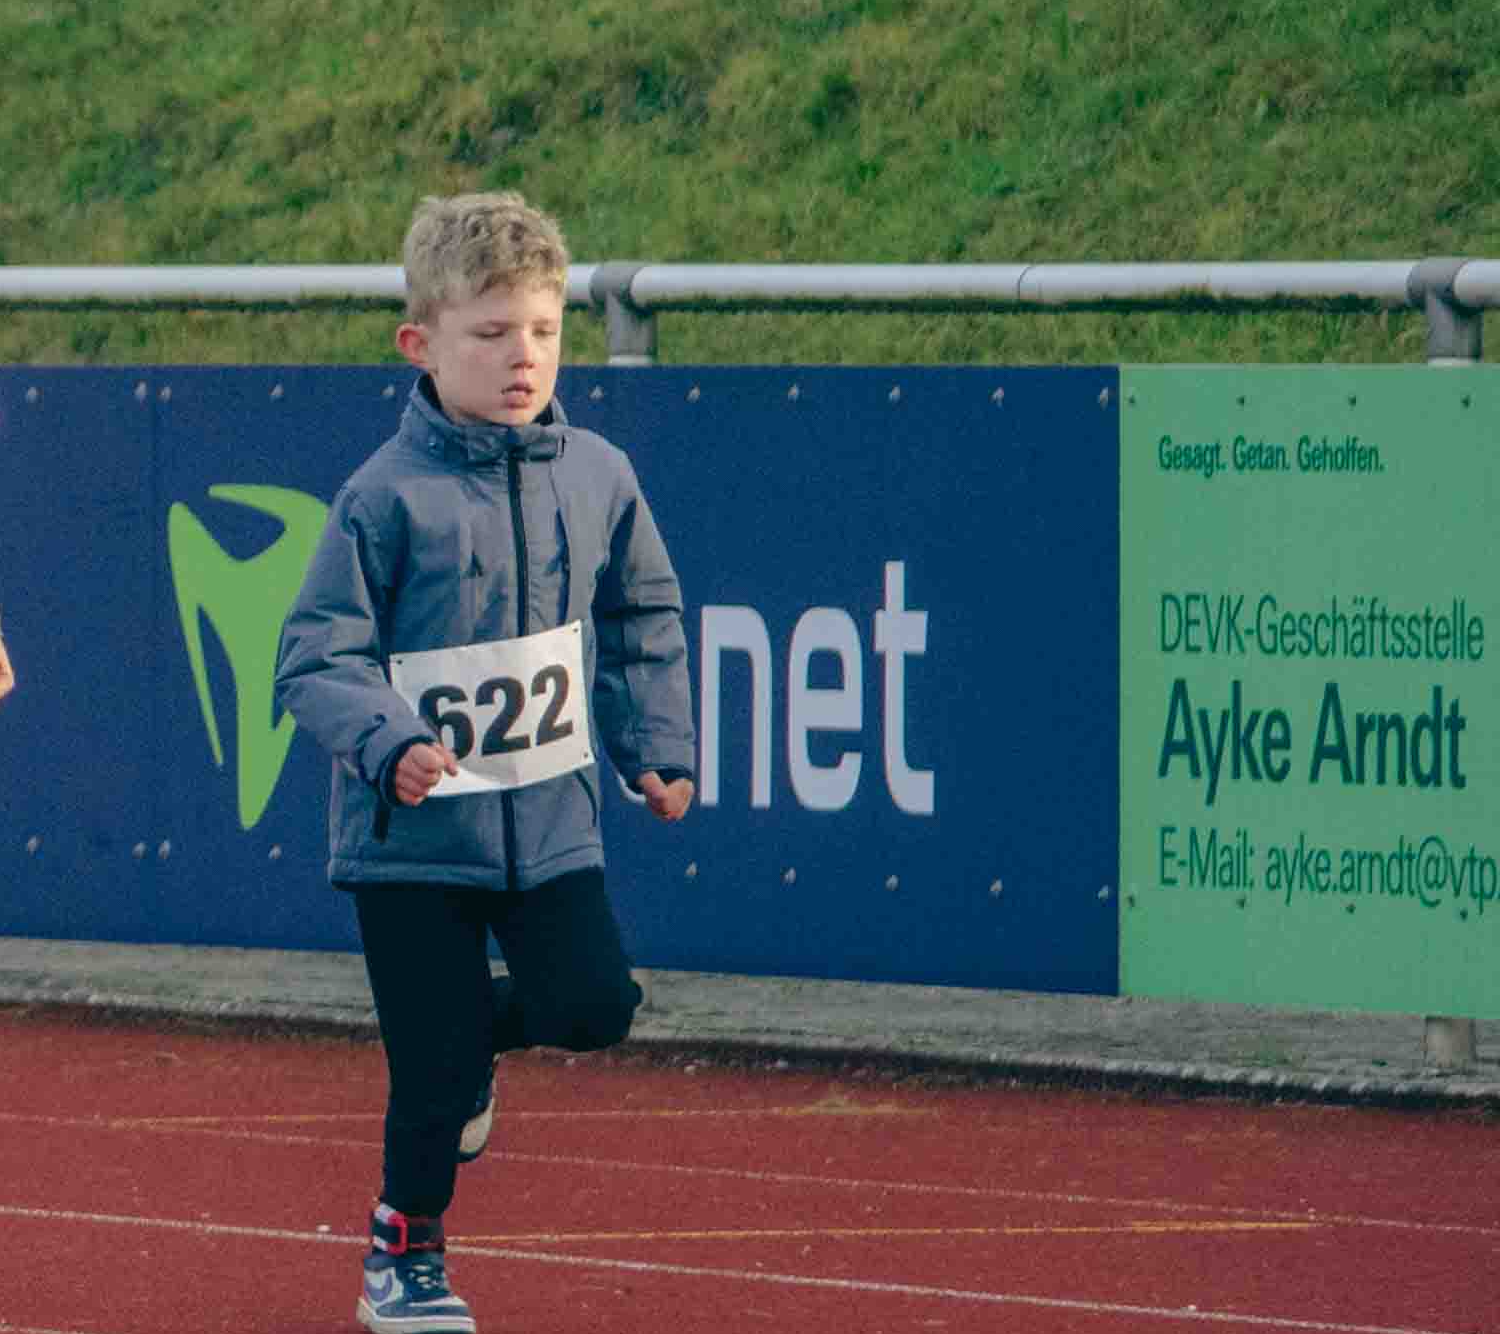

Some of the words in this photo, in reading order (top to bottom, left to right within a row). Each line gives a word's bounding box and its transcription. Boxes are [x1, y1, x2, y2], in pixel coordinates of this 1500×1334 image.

[1158, 434, 1228, 478] Gesagt.
[1232, 434, 1291, 471] Getan.
[1297, 435, 1386, 473] Geholfen.
[1159, 593, 1485, 661] DEVK-Geschäftsstelle
[418, 664, 573, 761] 622
[619, 561, 935, 815] net
[1157, 678, 1292, 806] Ayke
[1309, 681, 1467, 790] Arndt
[1159, 827, 1255, 893] E-Mail:
